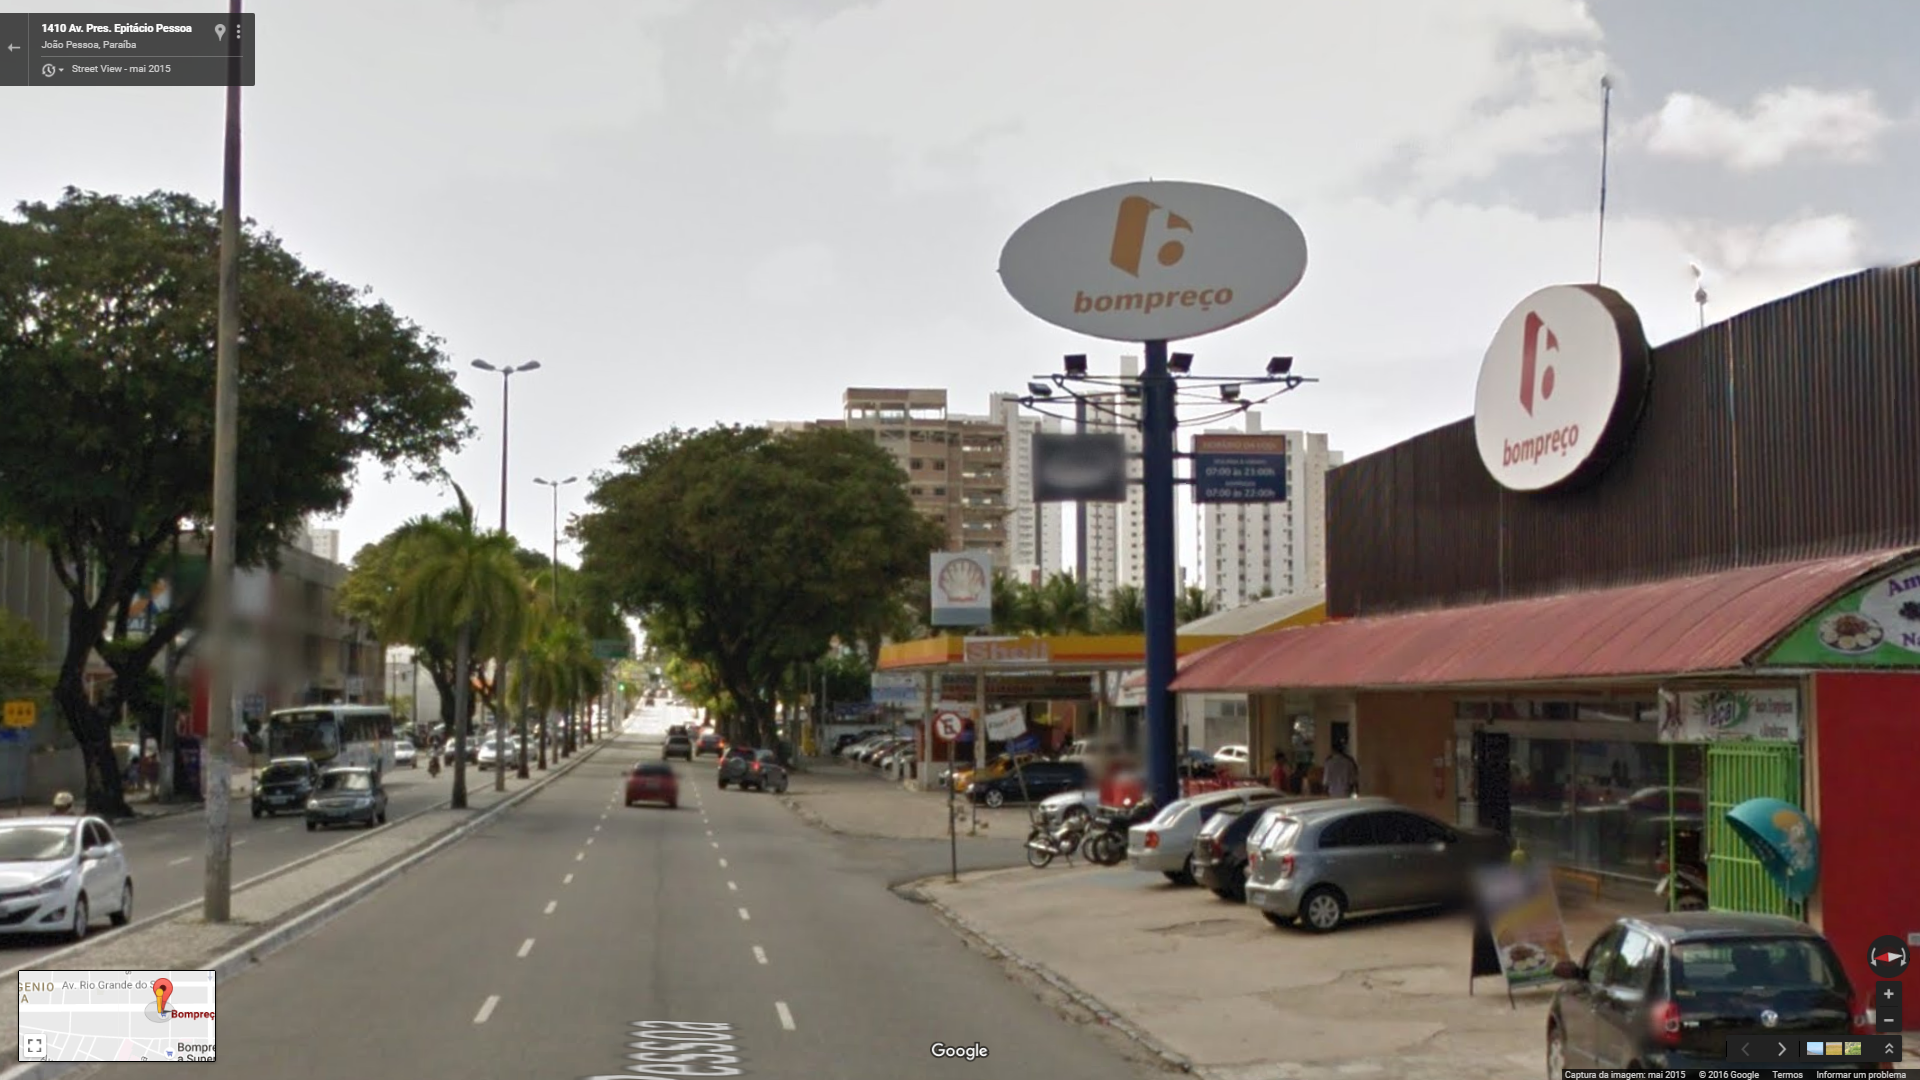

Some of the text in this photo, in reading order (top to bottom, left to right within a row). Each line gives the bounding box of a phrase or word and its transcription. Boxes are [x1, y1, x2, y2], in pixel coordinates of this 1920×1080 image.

[1073, 287, 1234, 315] bompreço
[1502, 424, 1580, 467] bompreço
[967, 641, 1048, 661] Shell
